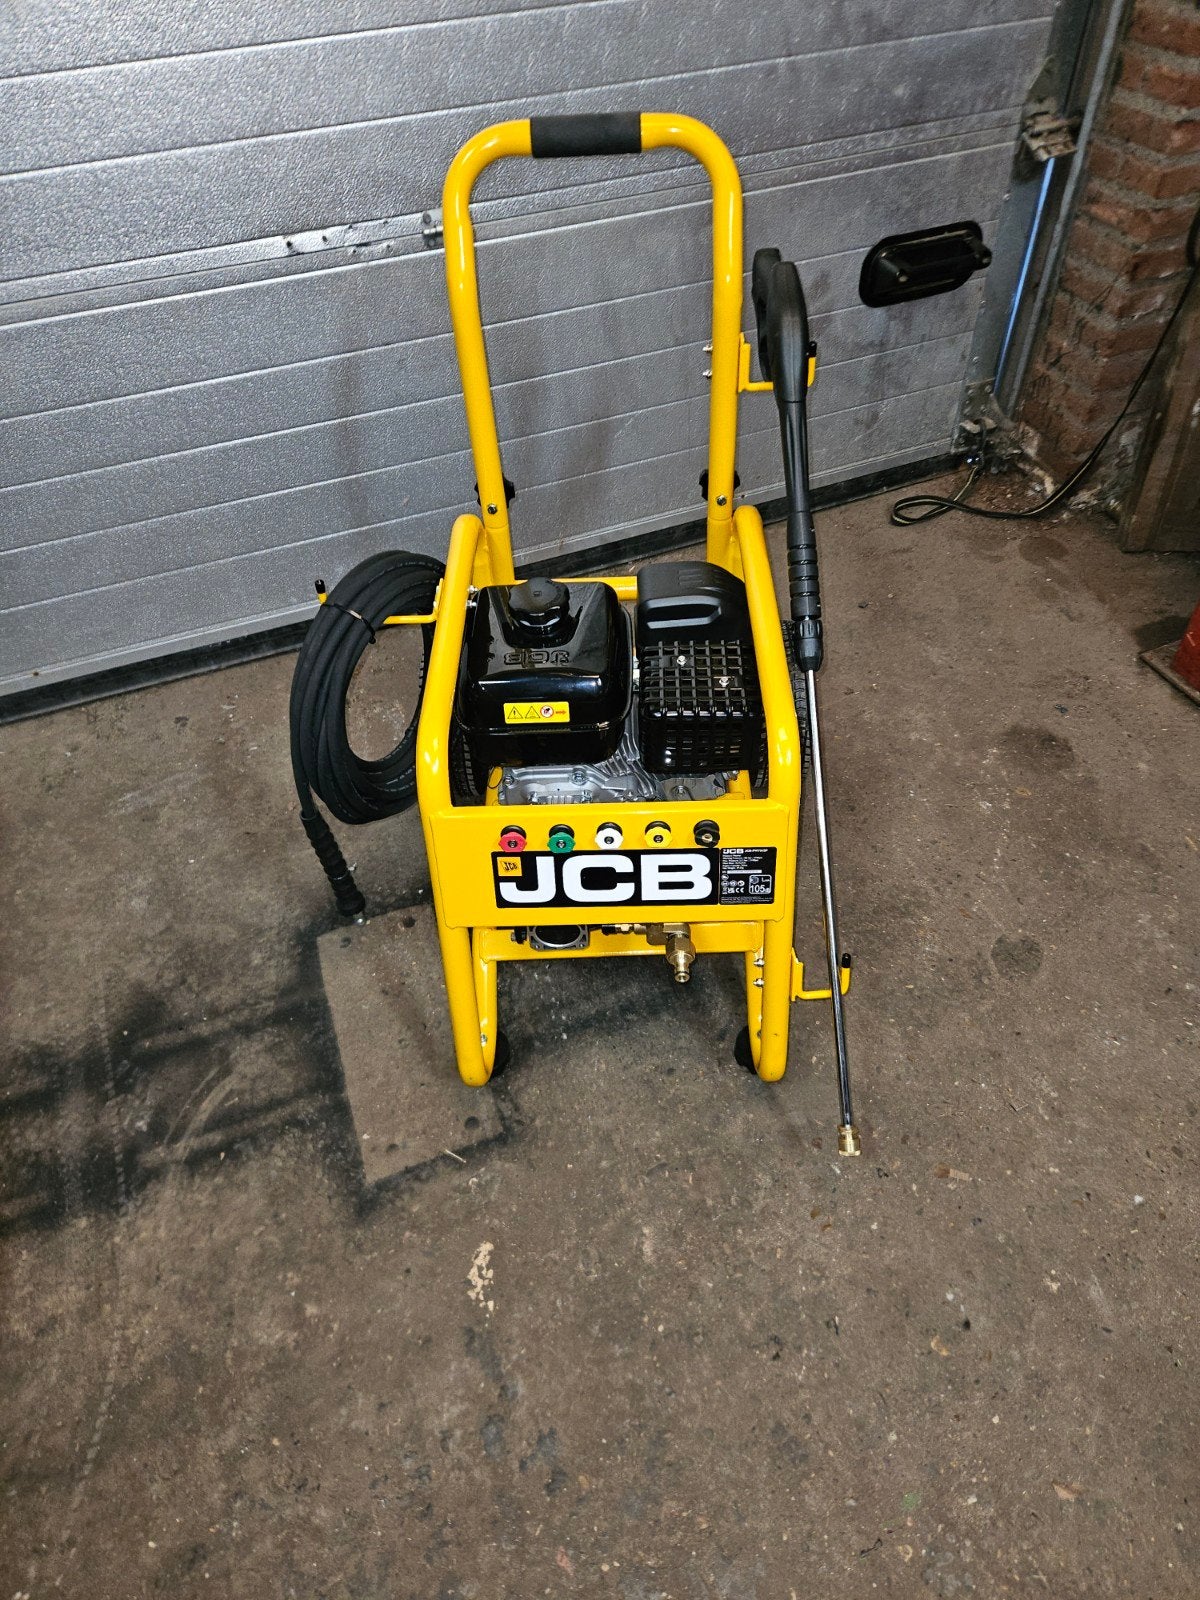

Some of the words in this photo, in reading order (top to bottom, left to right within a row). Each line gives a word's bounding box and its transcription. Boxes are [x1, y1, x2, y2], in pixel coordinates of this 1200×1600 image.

[504, 650, 570, 666] JCB
[502, 861, 518, 871] JCB
[500, 853, 713, 903] JCB
